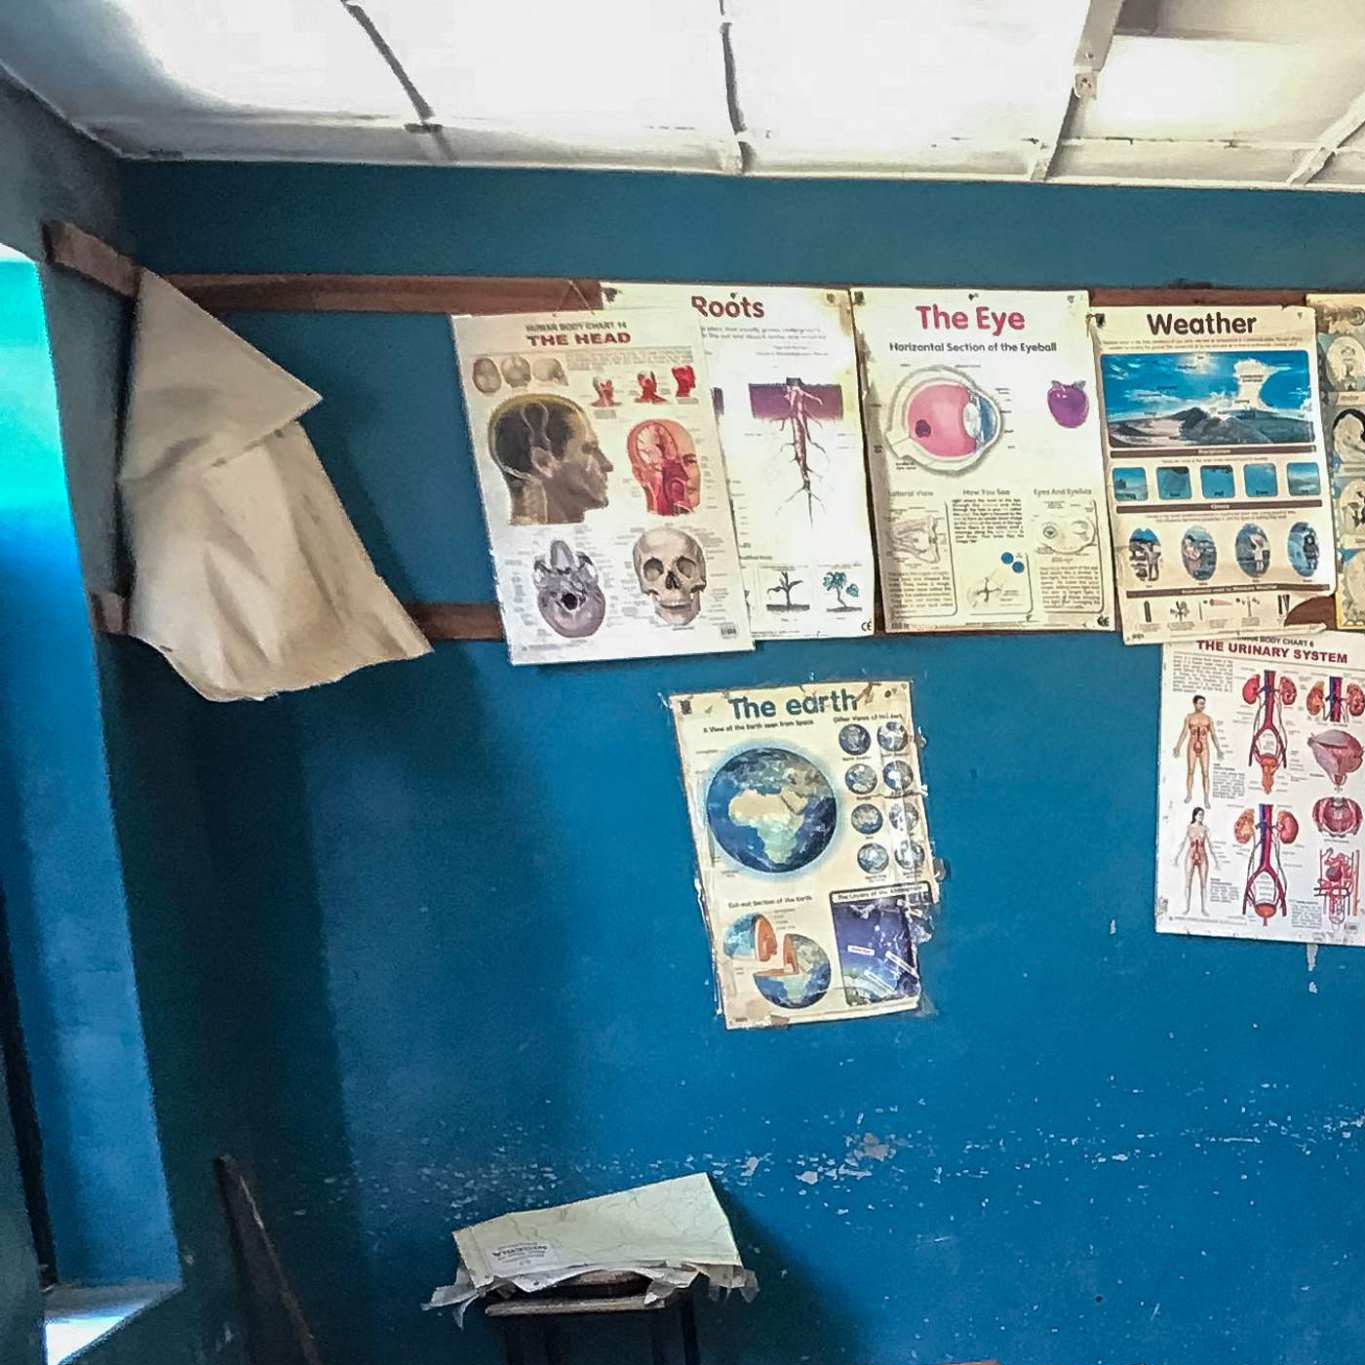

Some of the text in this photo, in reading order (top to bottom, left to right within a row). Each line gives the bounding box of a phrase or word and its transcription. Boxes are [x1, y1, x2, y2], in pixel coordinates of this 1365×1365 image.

[691, 295, 765, 318] Roots
[915, 303, 1026, 336] The Eye
[1146, 312, 1257, 336] Weather
[526, 332, 632, 347] THE HEAD
[889, 342, 1057, 354] Horizontal Section of the Eyeball
[1196, 640, 1348, 664] THE URINARY SYSTEM
[1259, 637, 1281, 645] BODY
[1282, 638, 1308, 647] CHART
[729, 689, 859, 720] The earth
